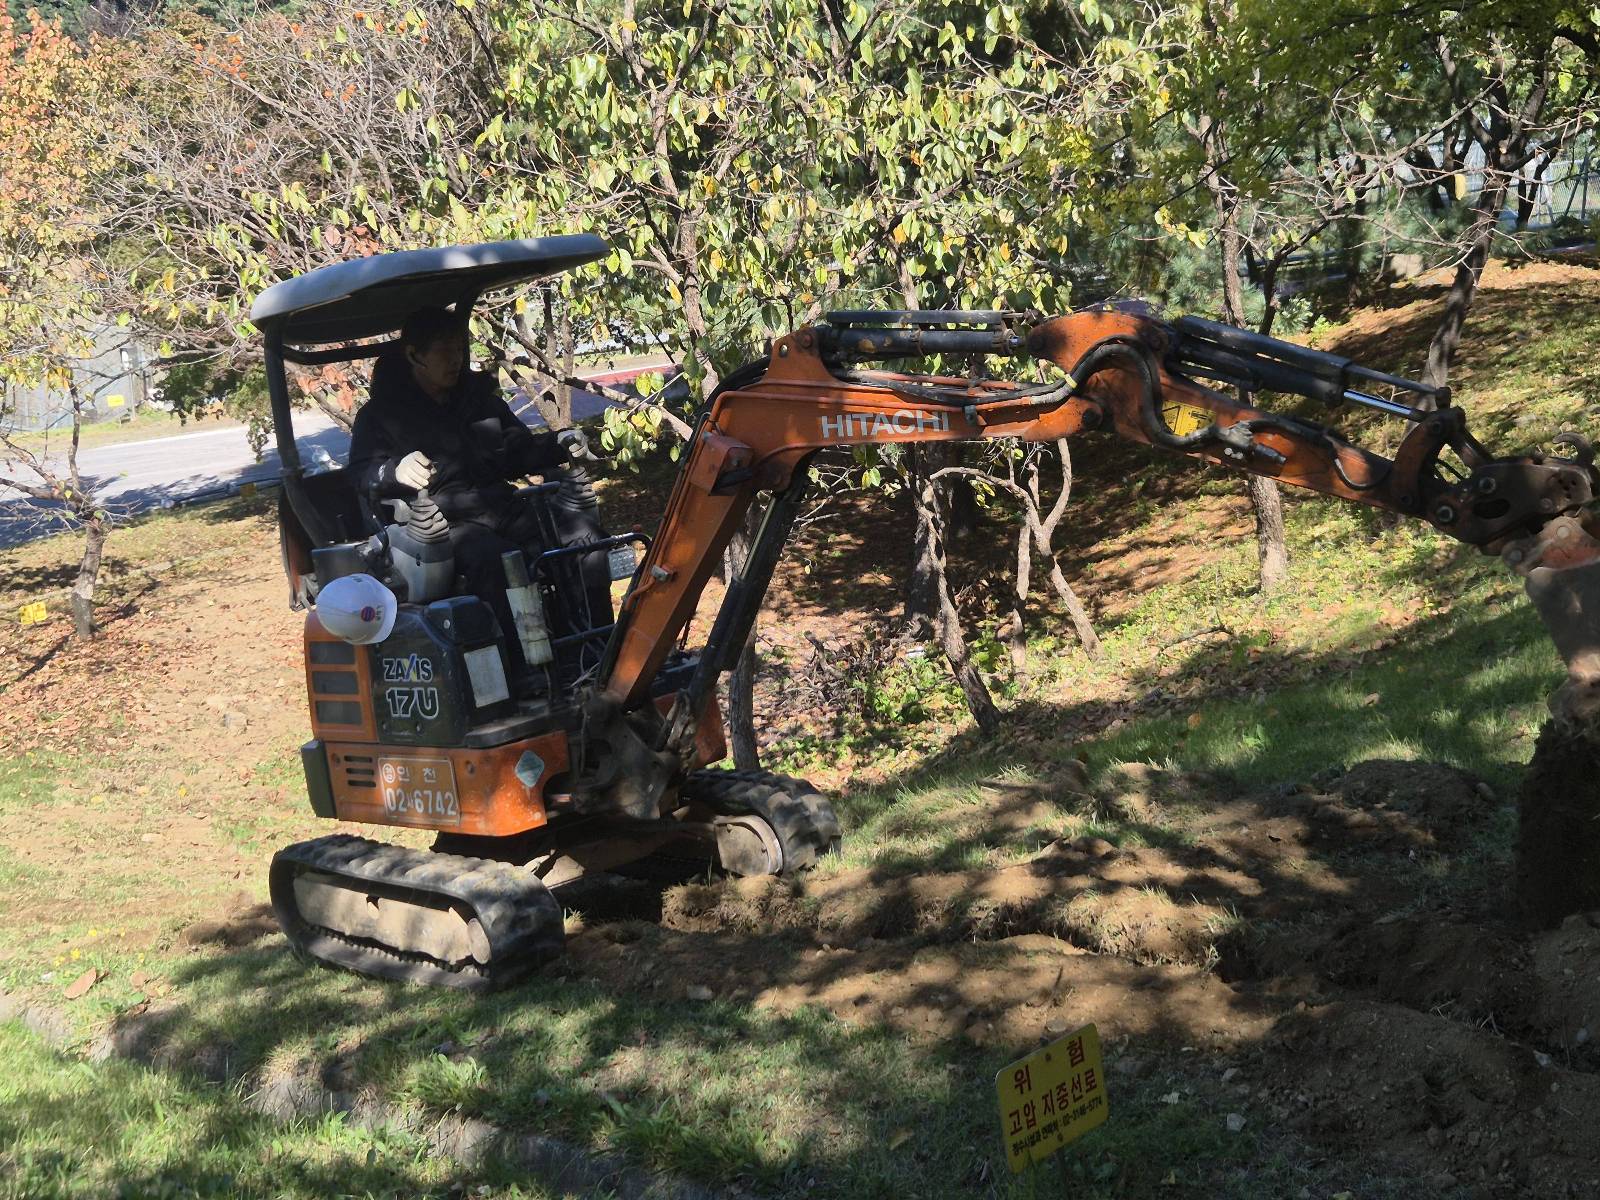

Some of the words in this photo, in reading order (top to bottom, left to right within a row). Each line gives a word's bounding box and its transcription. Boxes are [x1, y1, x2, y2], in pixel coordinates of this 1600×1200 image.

[821, 409, 950, 439] HITACHI
[383, 653, 433, 683] ZAXIS
[385, 687, 439, 719] 17U
[1009, 1100, 1037, 1136] 고압
[1042, 1068, 1098, 1116] 지중선로
